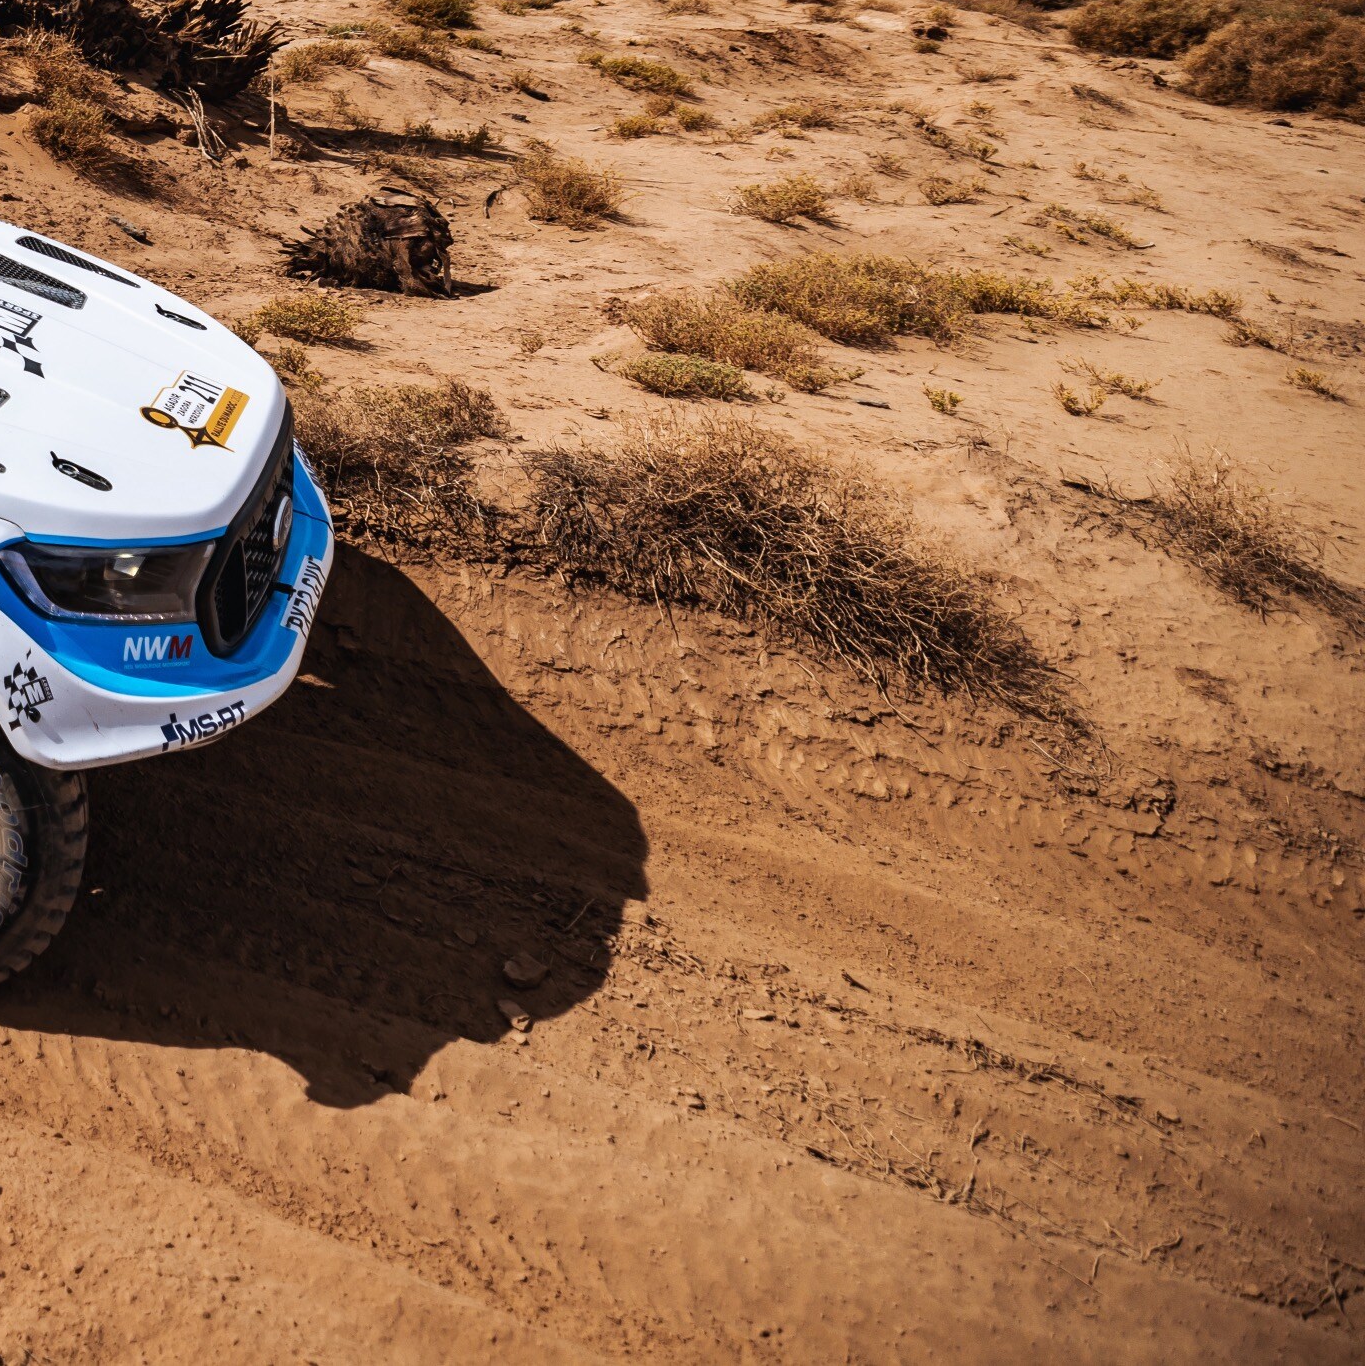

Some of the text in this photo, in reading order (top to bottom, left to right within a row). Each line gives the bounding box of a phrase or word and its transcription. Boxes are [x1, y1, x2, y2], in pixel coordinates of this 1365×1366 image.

[164, 393, 181, 412] AGADIR
[178, 374, 222, 404] 211
[211, 420, 226, 438] RALLYE
[123, 635, 194, 662] NWM
[174, 700, 246, 746] MS-RT
